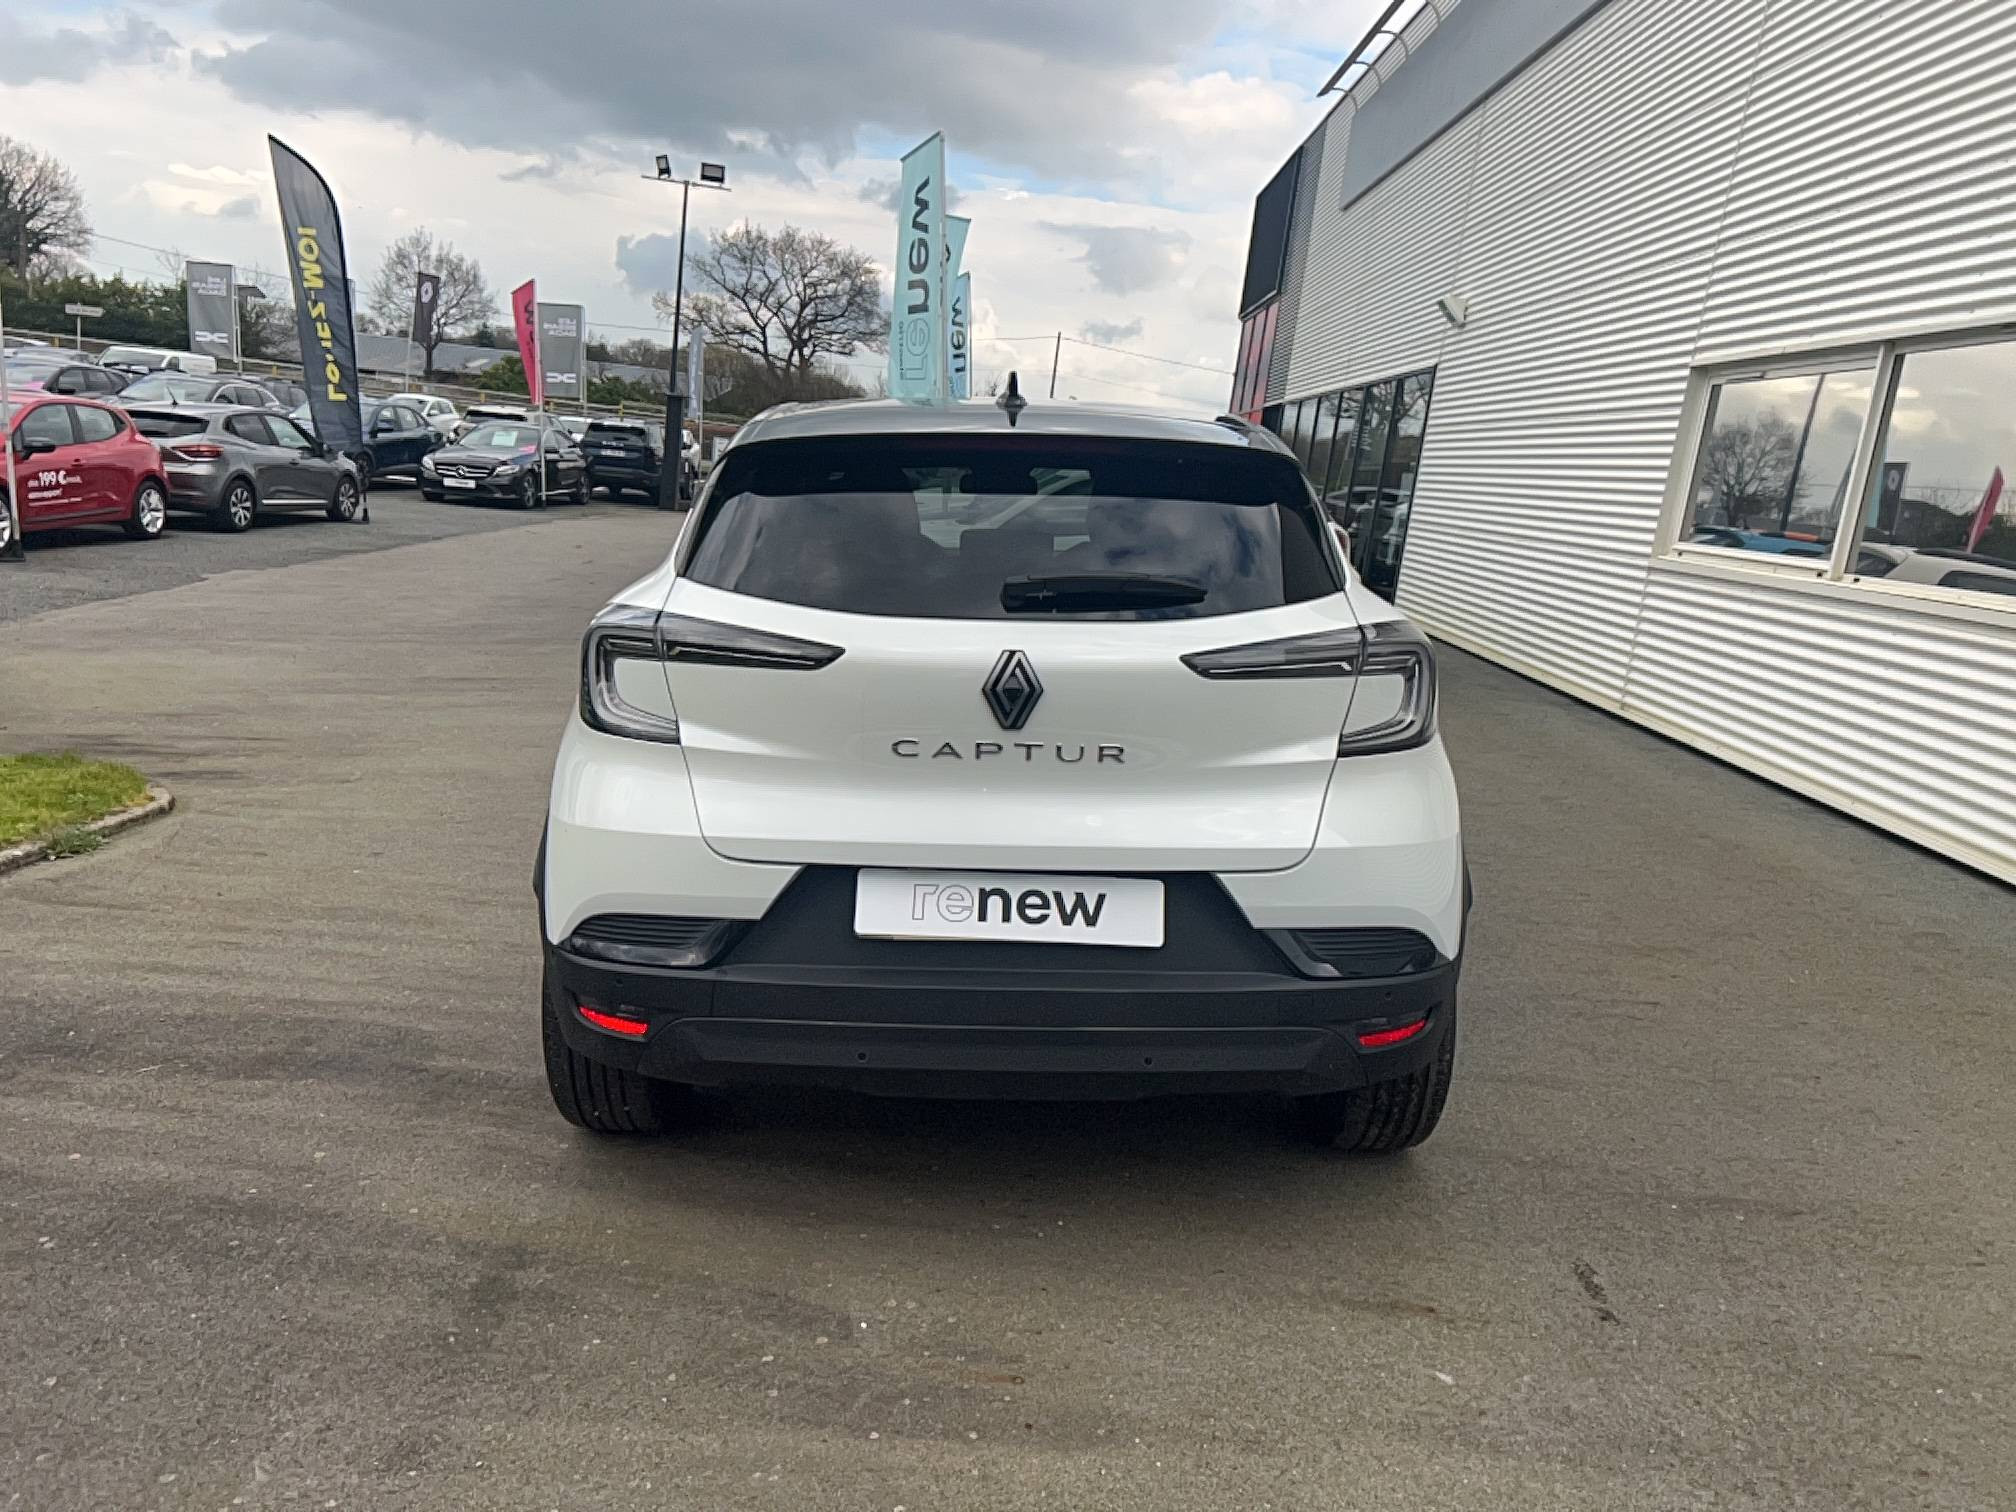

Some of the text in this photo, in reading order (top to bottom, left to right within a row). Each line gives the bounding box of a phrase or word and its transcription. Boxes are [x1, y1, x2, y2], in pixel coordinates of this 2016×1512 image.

[39, 471, 57, 486] 199
[891, 738, 1126, 763] CAPTUR
[911, 883, 1107, 928] renew
